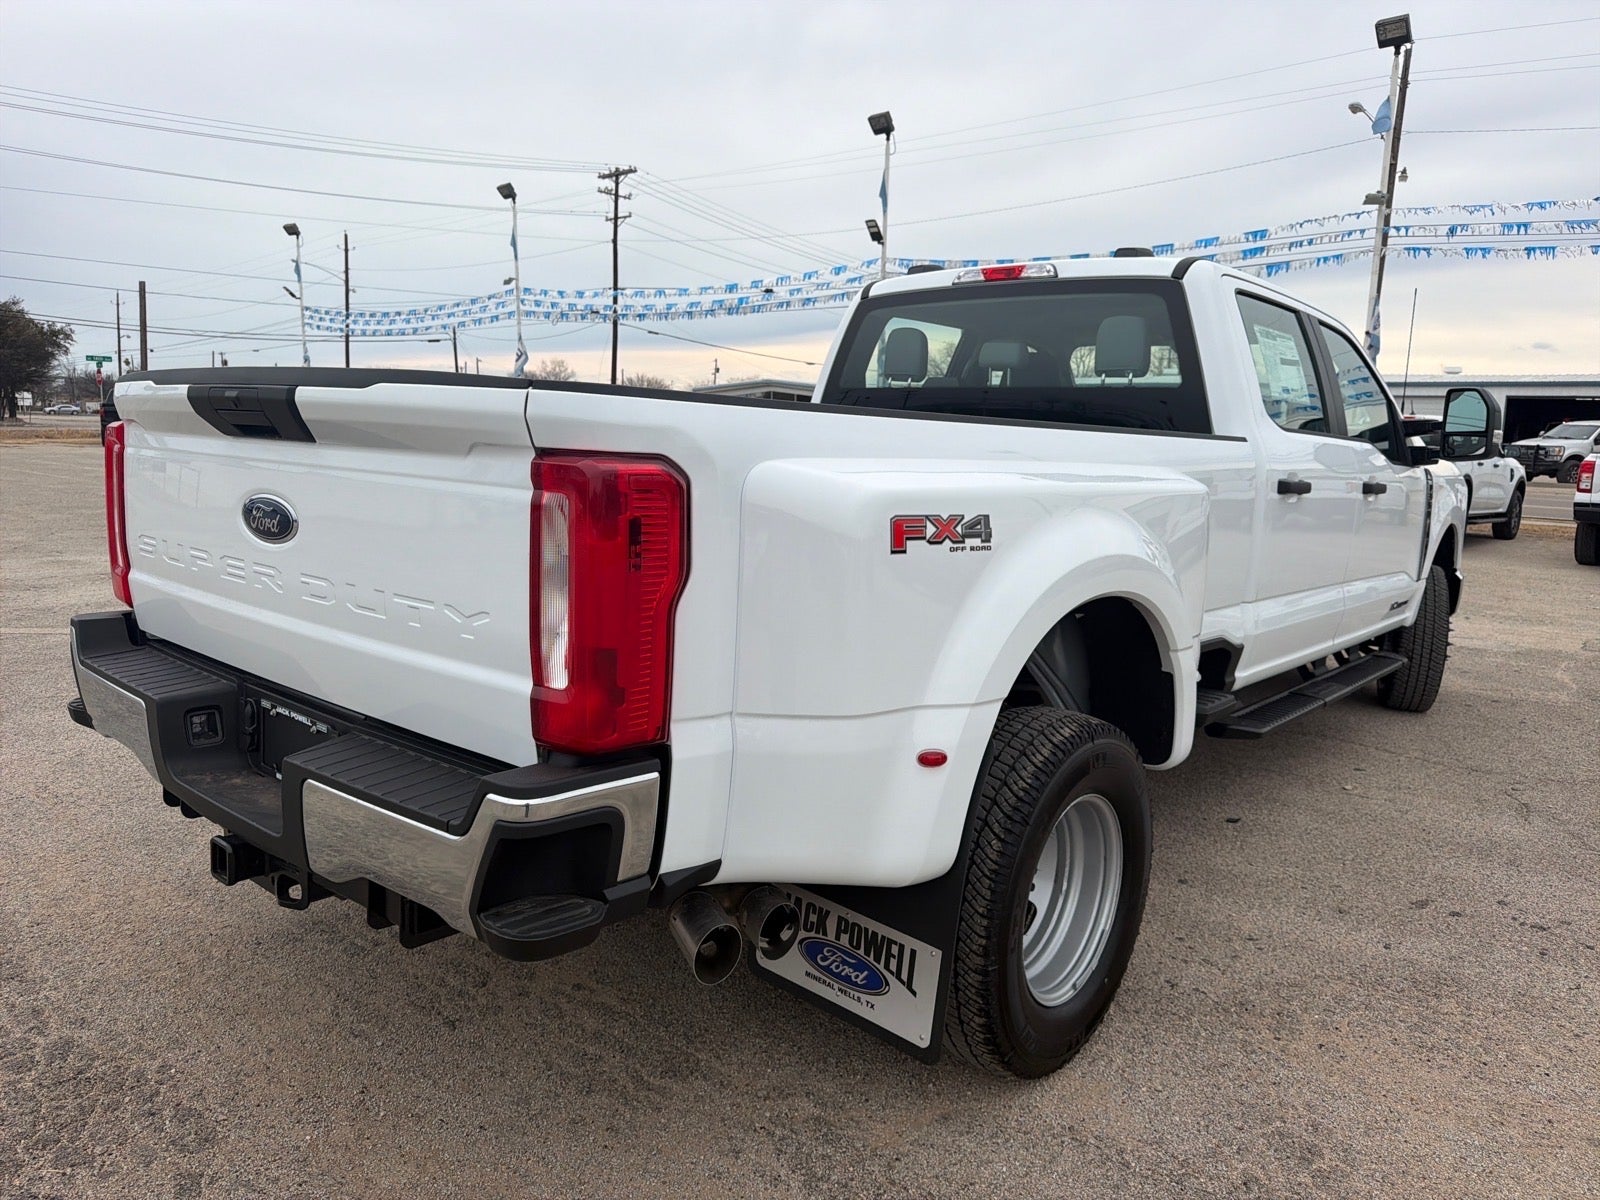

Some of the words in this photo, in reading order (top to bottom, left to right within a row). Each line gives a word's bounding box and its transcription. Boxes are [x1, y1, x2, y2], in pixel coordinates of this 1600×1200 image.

[250, 503, 281, 533] Ford
[890, 514, 992, 554] FX4
[949, 545, 967, 553] OFF
[138, 534, 284, 594] SUPER
[300, 572, 491, 640] DUTY
[290, 711, 313, 726] POWELL
[816, 947, 869, 986] Ford
[834, 914, 918, 998] POWELL
[804, 970, 836, 991] MINERAL
[837, 985, 864, 1007] WELLS,
[864, 1000, 876, 1011] TX
